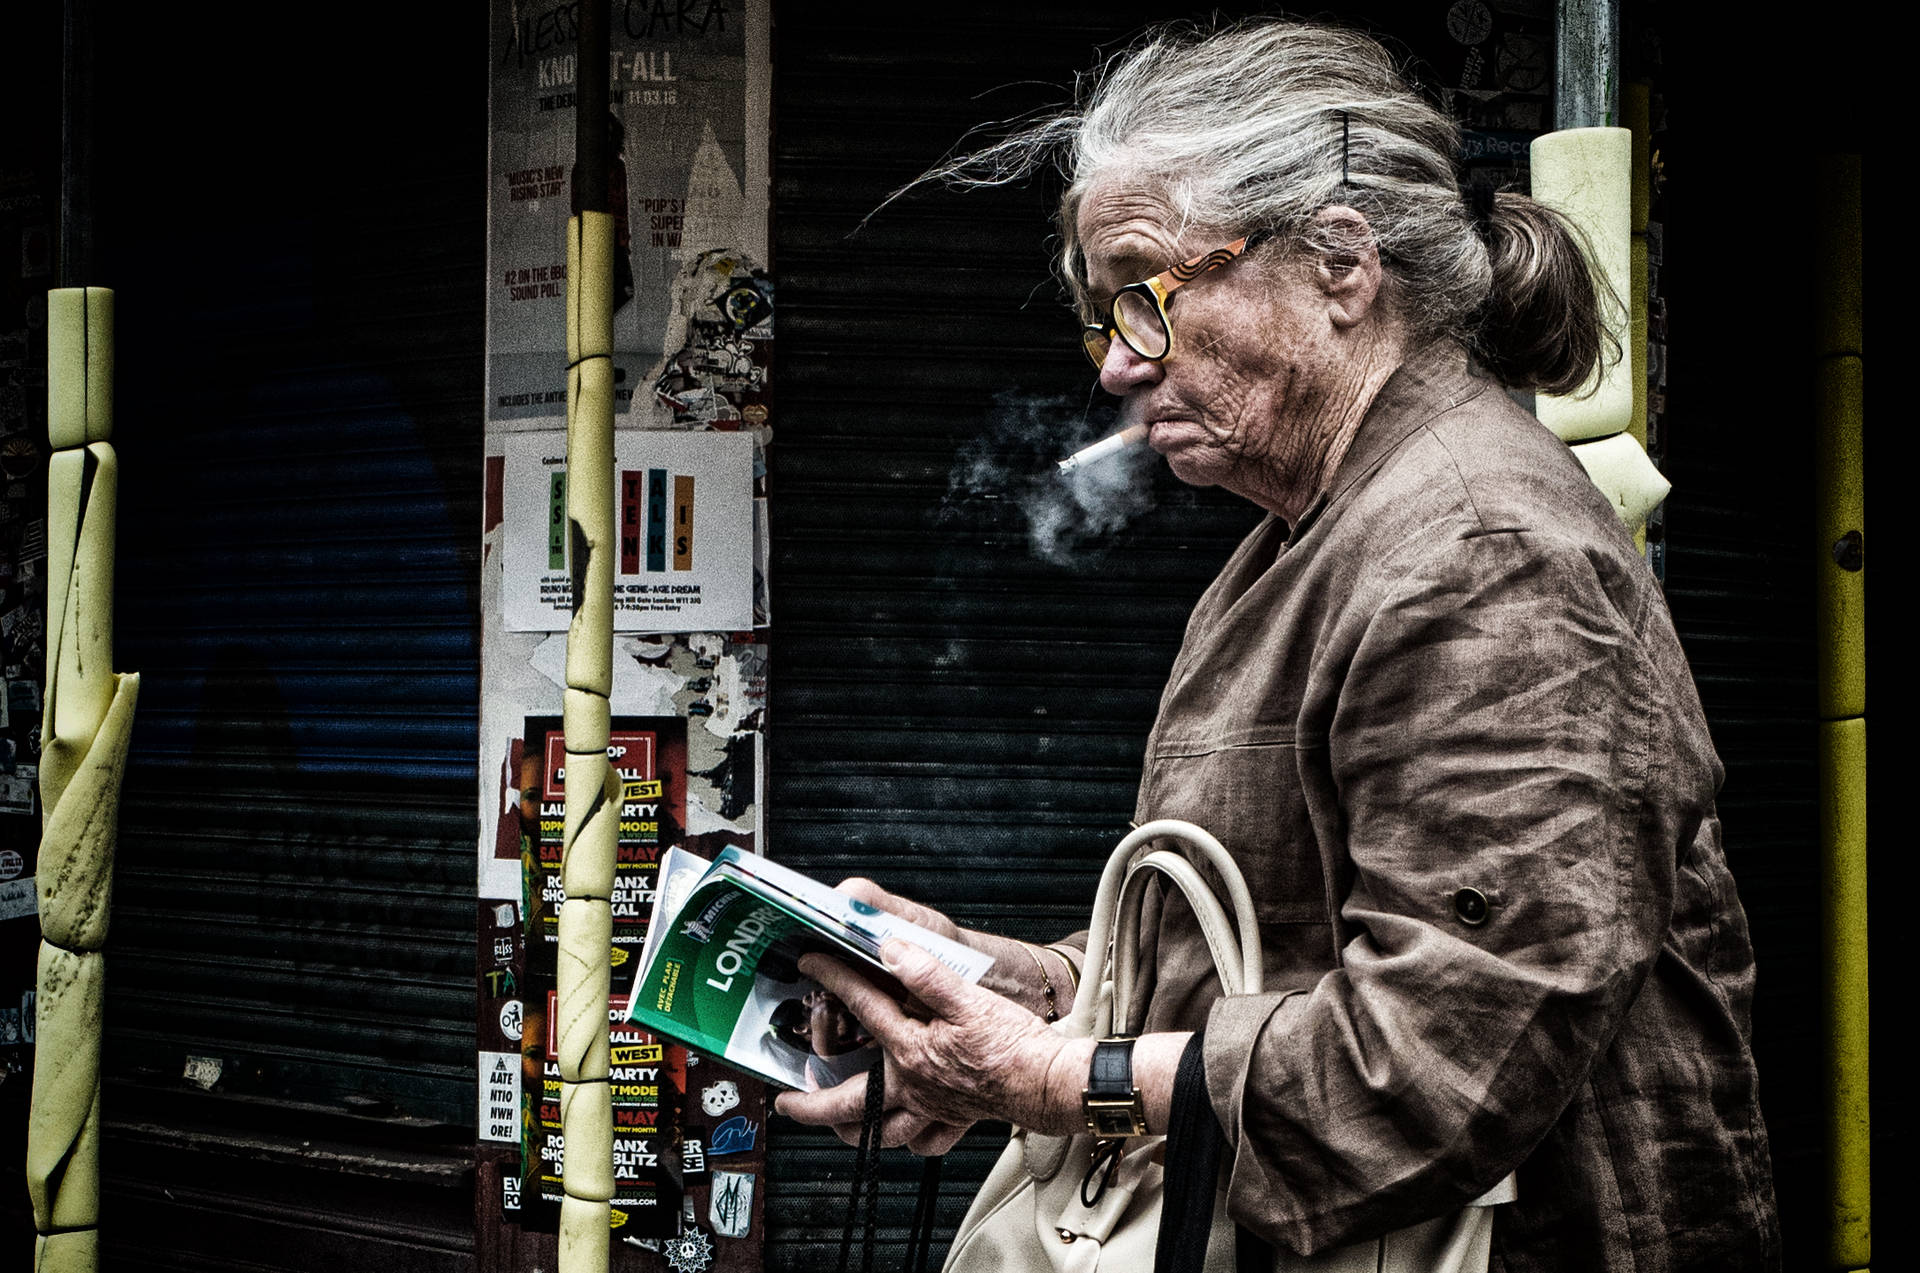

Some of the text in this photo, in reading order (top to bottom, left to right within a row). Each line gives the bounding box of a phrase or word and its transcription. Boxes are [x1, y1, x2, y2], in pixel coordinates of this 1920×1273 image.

[531, 266, 548, 282] THE
[510, 282, 561, 301] SOUND POLL
[619, 822, 658, 832] MODE
[617, 847, 659, 861] MAY
[662, 961, 674, 985] PLAN
[615, 1047, 660, 1061] WEST
[490, 1071, 513, 1085] AATE
[490, 1089, 512, 1102] NTIO
[619, 1086, 658, 1096] MODE
[490, 1106, 513, 1120] NWH
[617, 1111, 659, 1125] MAY
[490, 1124, 513, 1138] ORE!
[613, 1153, 657, 1167] BLITZ
